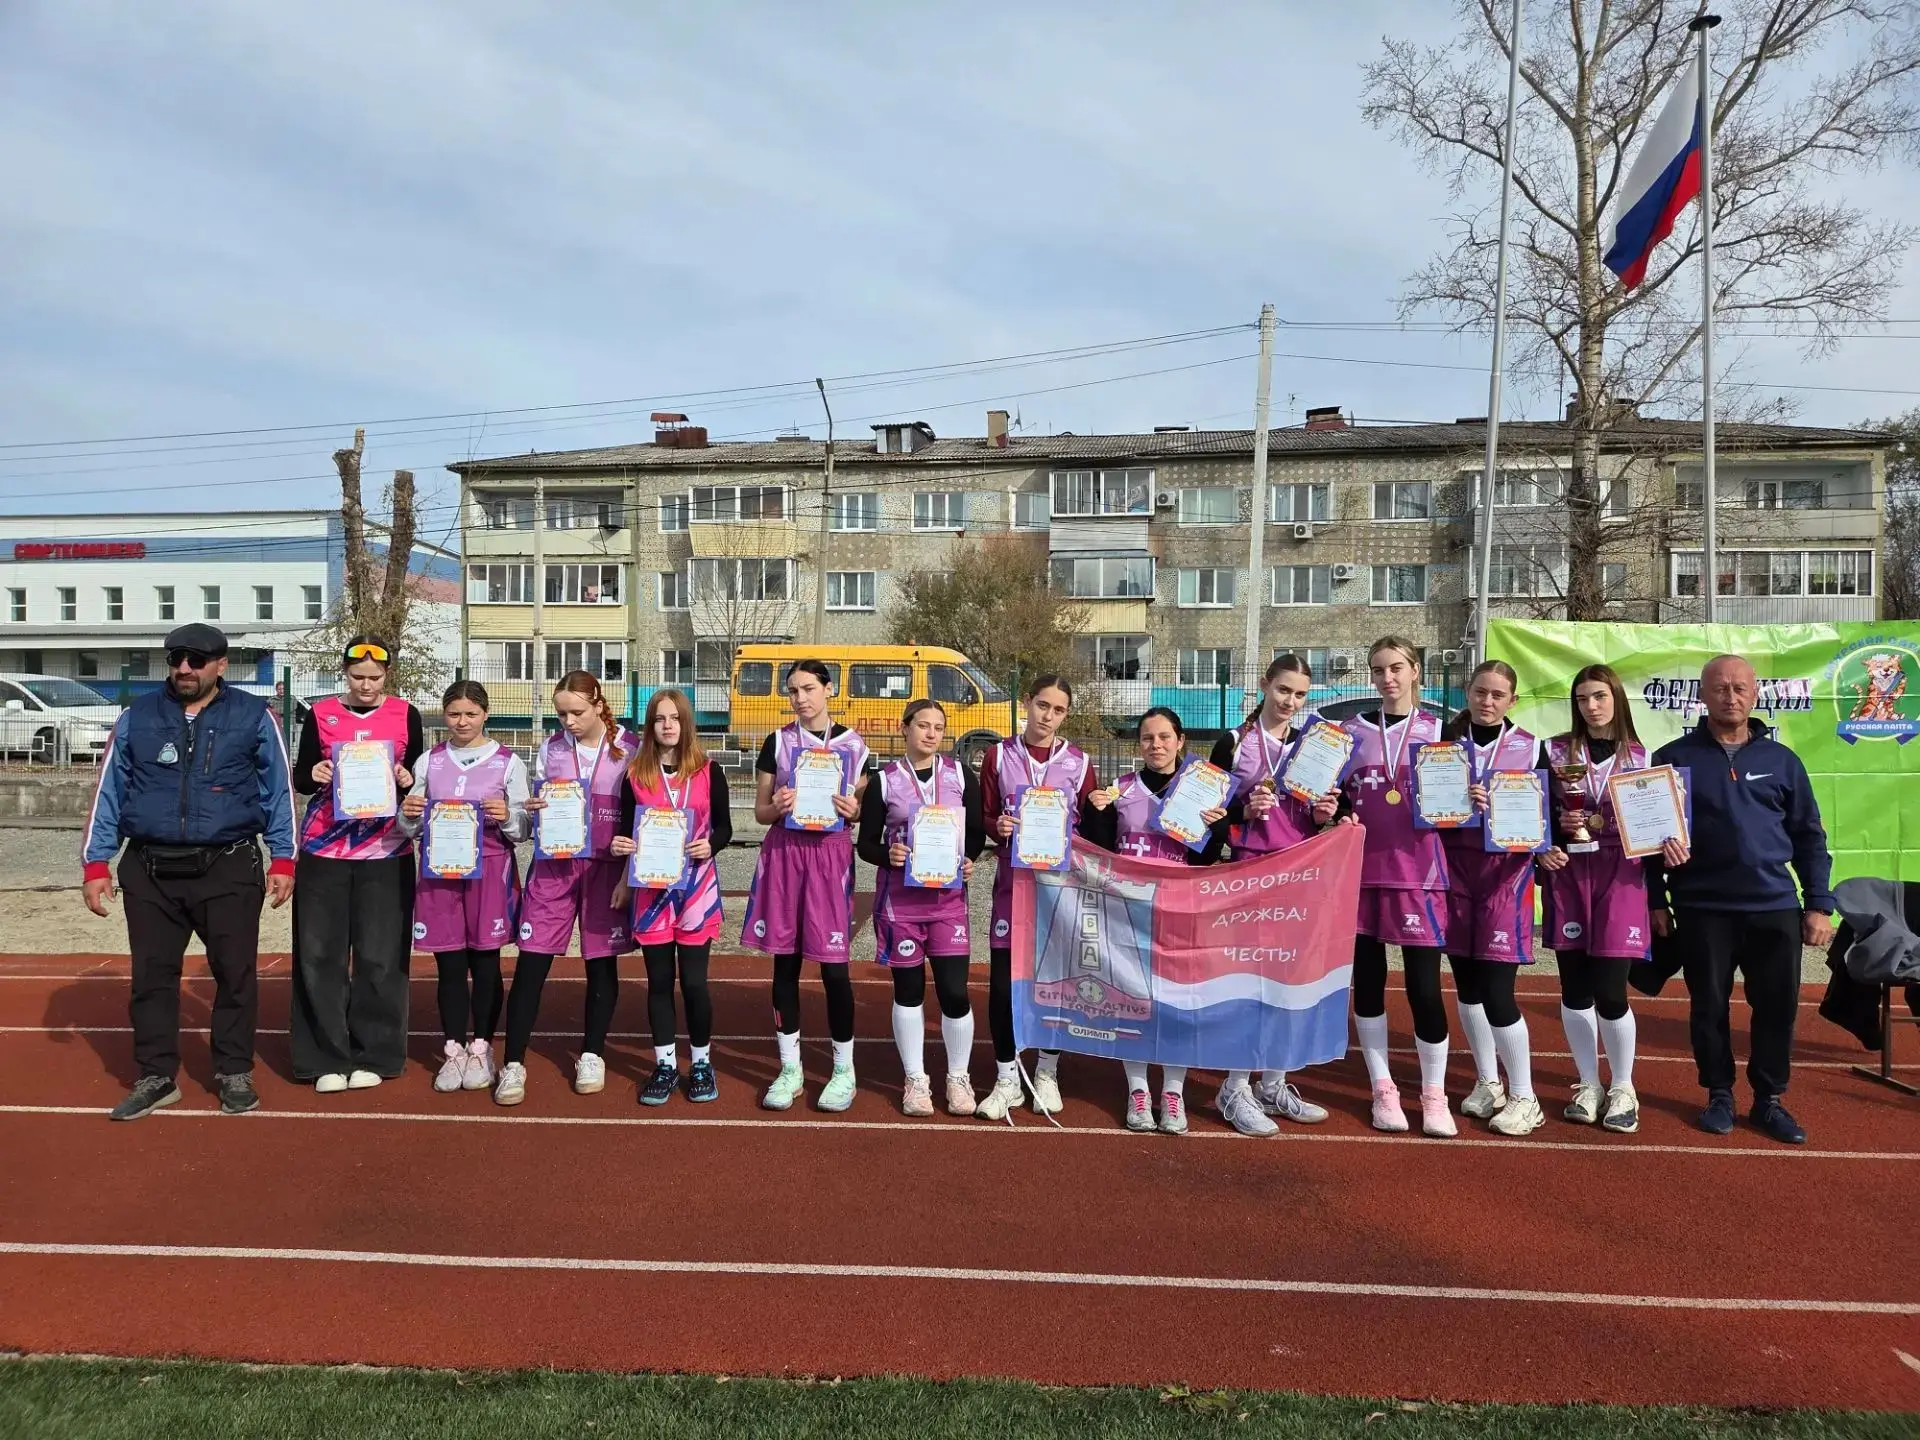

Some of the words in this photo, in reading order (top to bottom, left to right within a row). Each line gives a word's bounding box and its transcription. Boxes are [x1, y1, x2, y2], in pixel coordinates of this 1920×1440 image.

[1643, 678, 1814, 719] ФЕДЦИЯ
[1845, 723, 1882, 731] РУССКАЯ
[1884, 723, 1913, 731] ЛАПТА
[454, 775, 467, 797] 3
[1199, 868, 1320, 896] ЗДОРОВЬЕ!
[1212, 907, 1307, 928] ДРУЖБА!
[1223, 947, 1297, 962] ЧЕСТЬ!
[1039, 990, 1078, 1003] CITIUS
[1073, 1027, 1110, 1039] ОЛИМП
